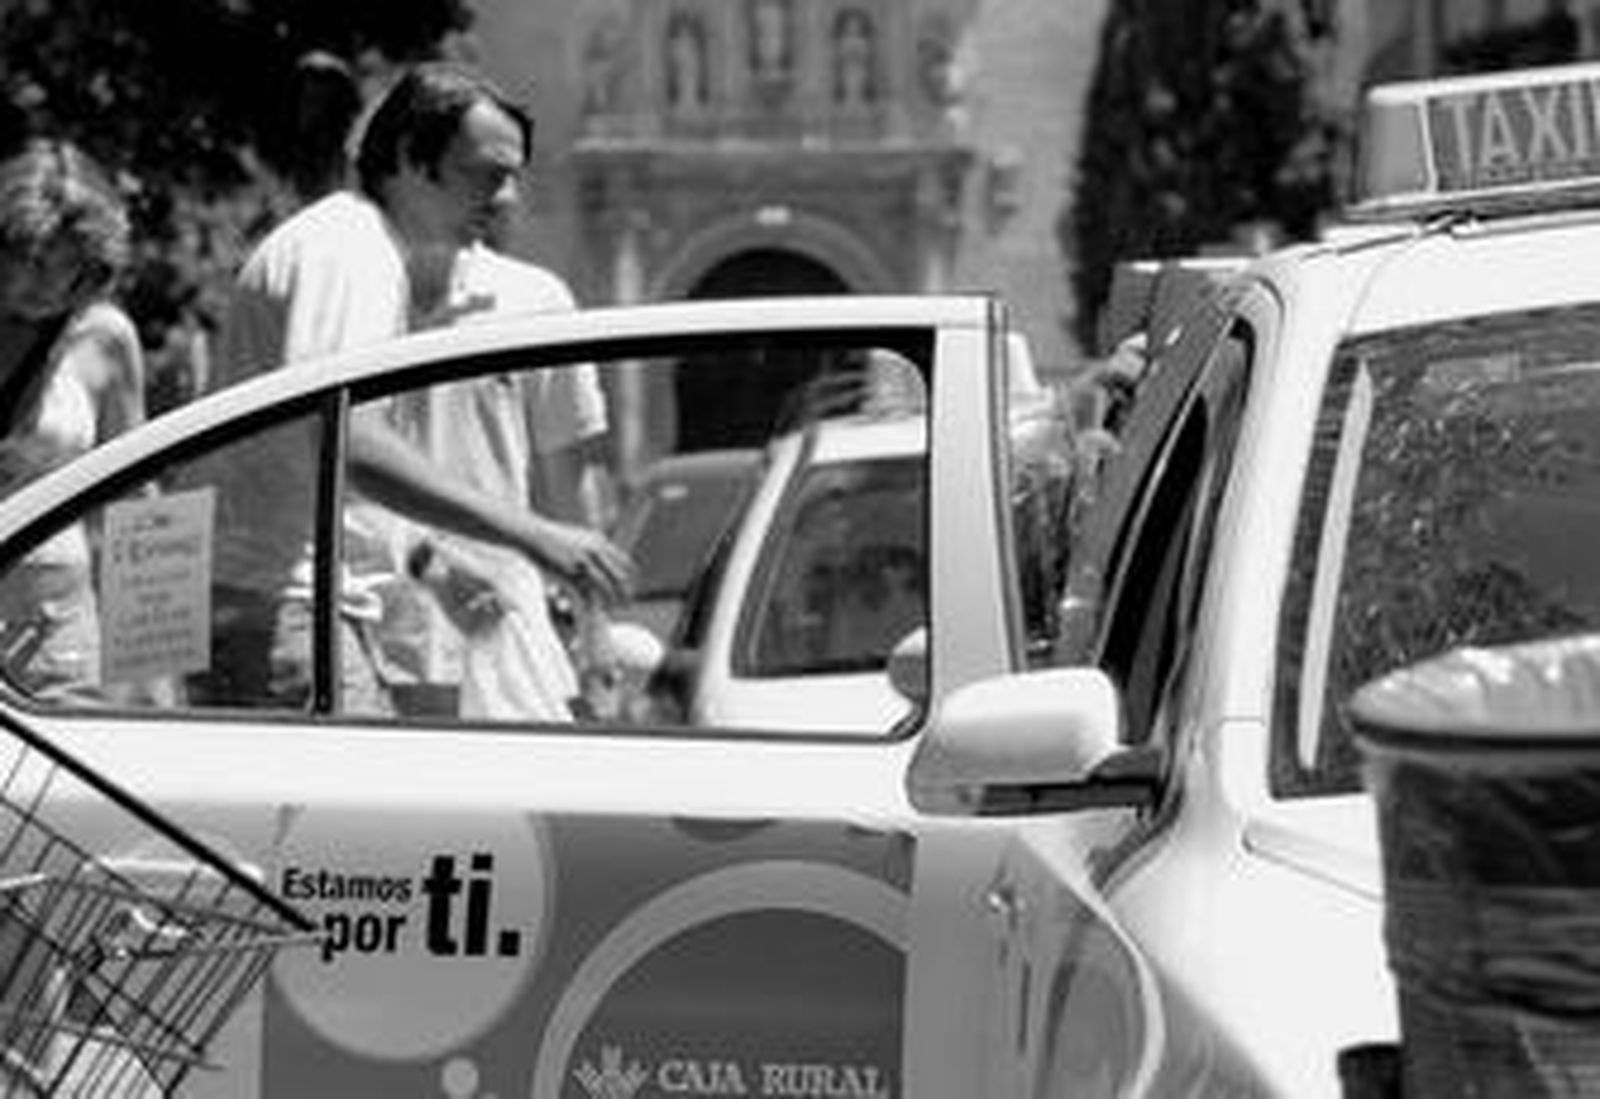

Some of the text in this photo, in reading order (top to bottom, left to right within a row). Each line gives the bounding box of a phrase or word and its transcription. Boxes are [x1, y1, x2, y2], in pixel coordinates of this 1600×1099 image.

[1438, 81, 1592, 175] TAXI
[282, 867, 412, 903] Estamos
[322, 853, 521, 963] por ti.
[657, 1059, 887, 1099] CAJA RURAL
